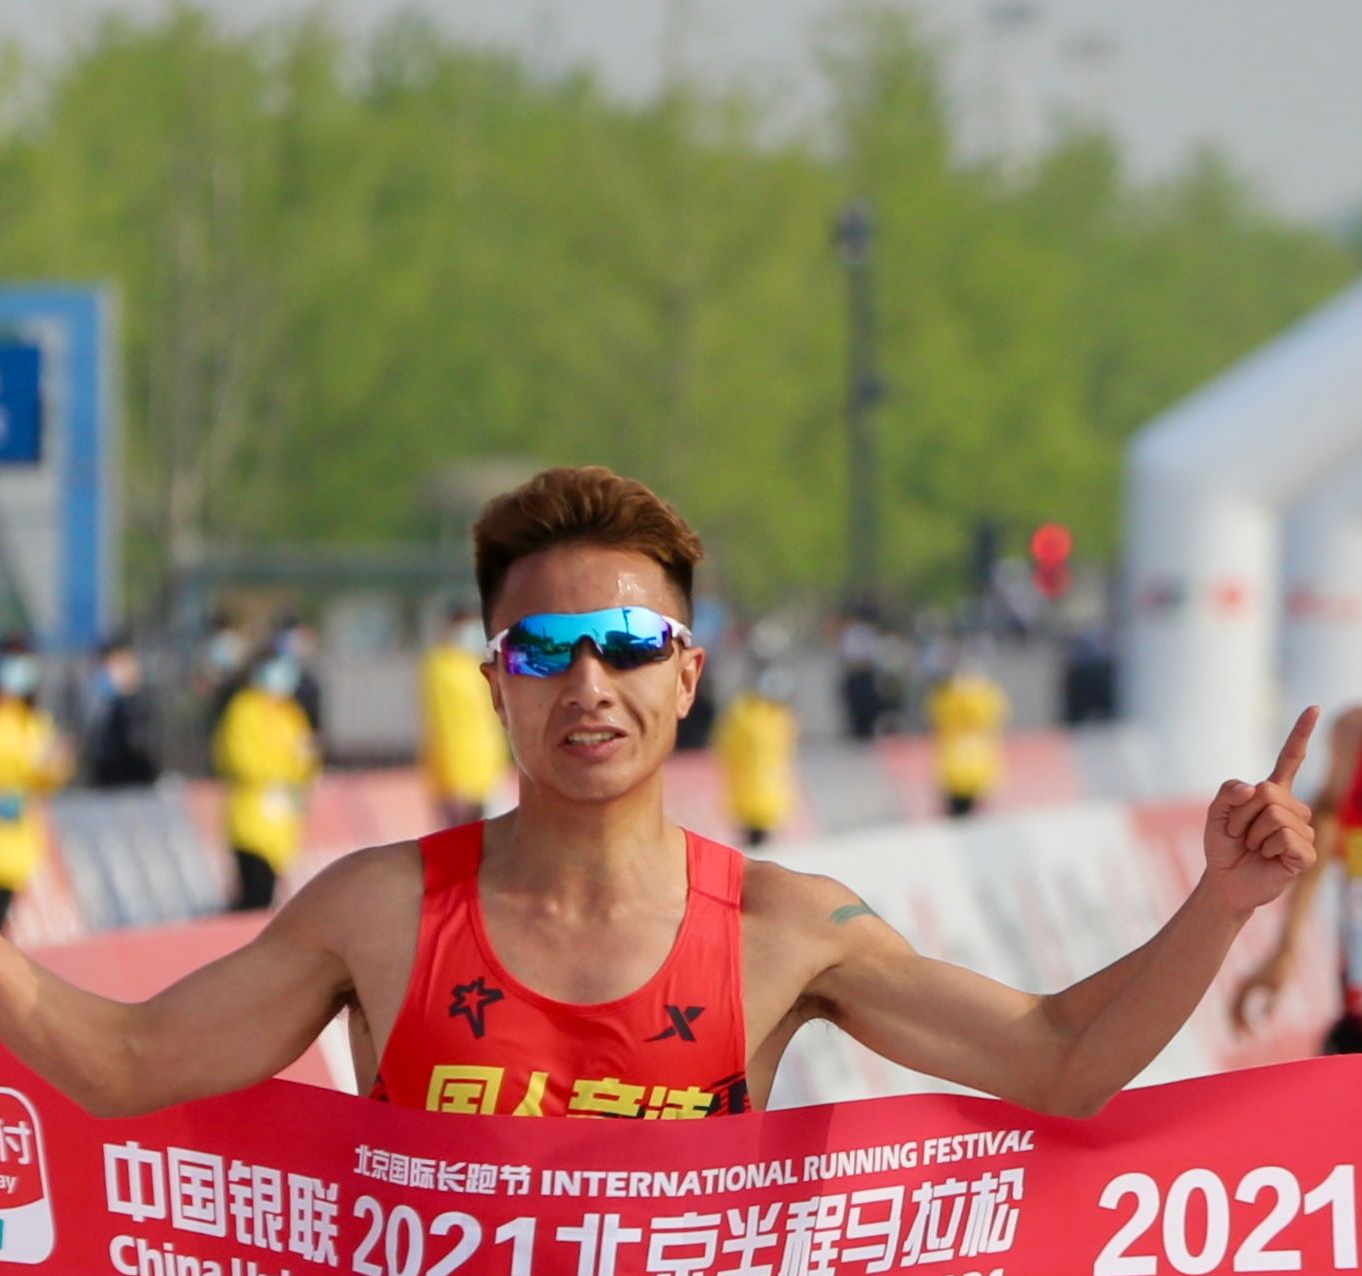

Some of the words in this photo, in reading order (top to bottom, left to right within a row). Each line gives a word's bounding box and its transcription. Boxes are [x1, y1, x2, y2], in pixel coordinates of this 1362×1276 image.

[103, 1140, 340, 1269] 中国银联
[353, 1144, 533, 1196] 北京国际长跑节
[539, 1160, 798, 1199] INTERNATIONAL
[802, 1142, 917, 1186] RUNNING
[923, 1129, 1035, 1166] FESTIVAL
